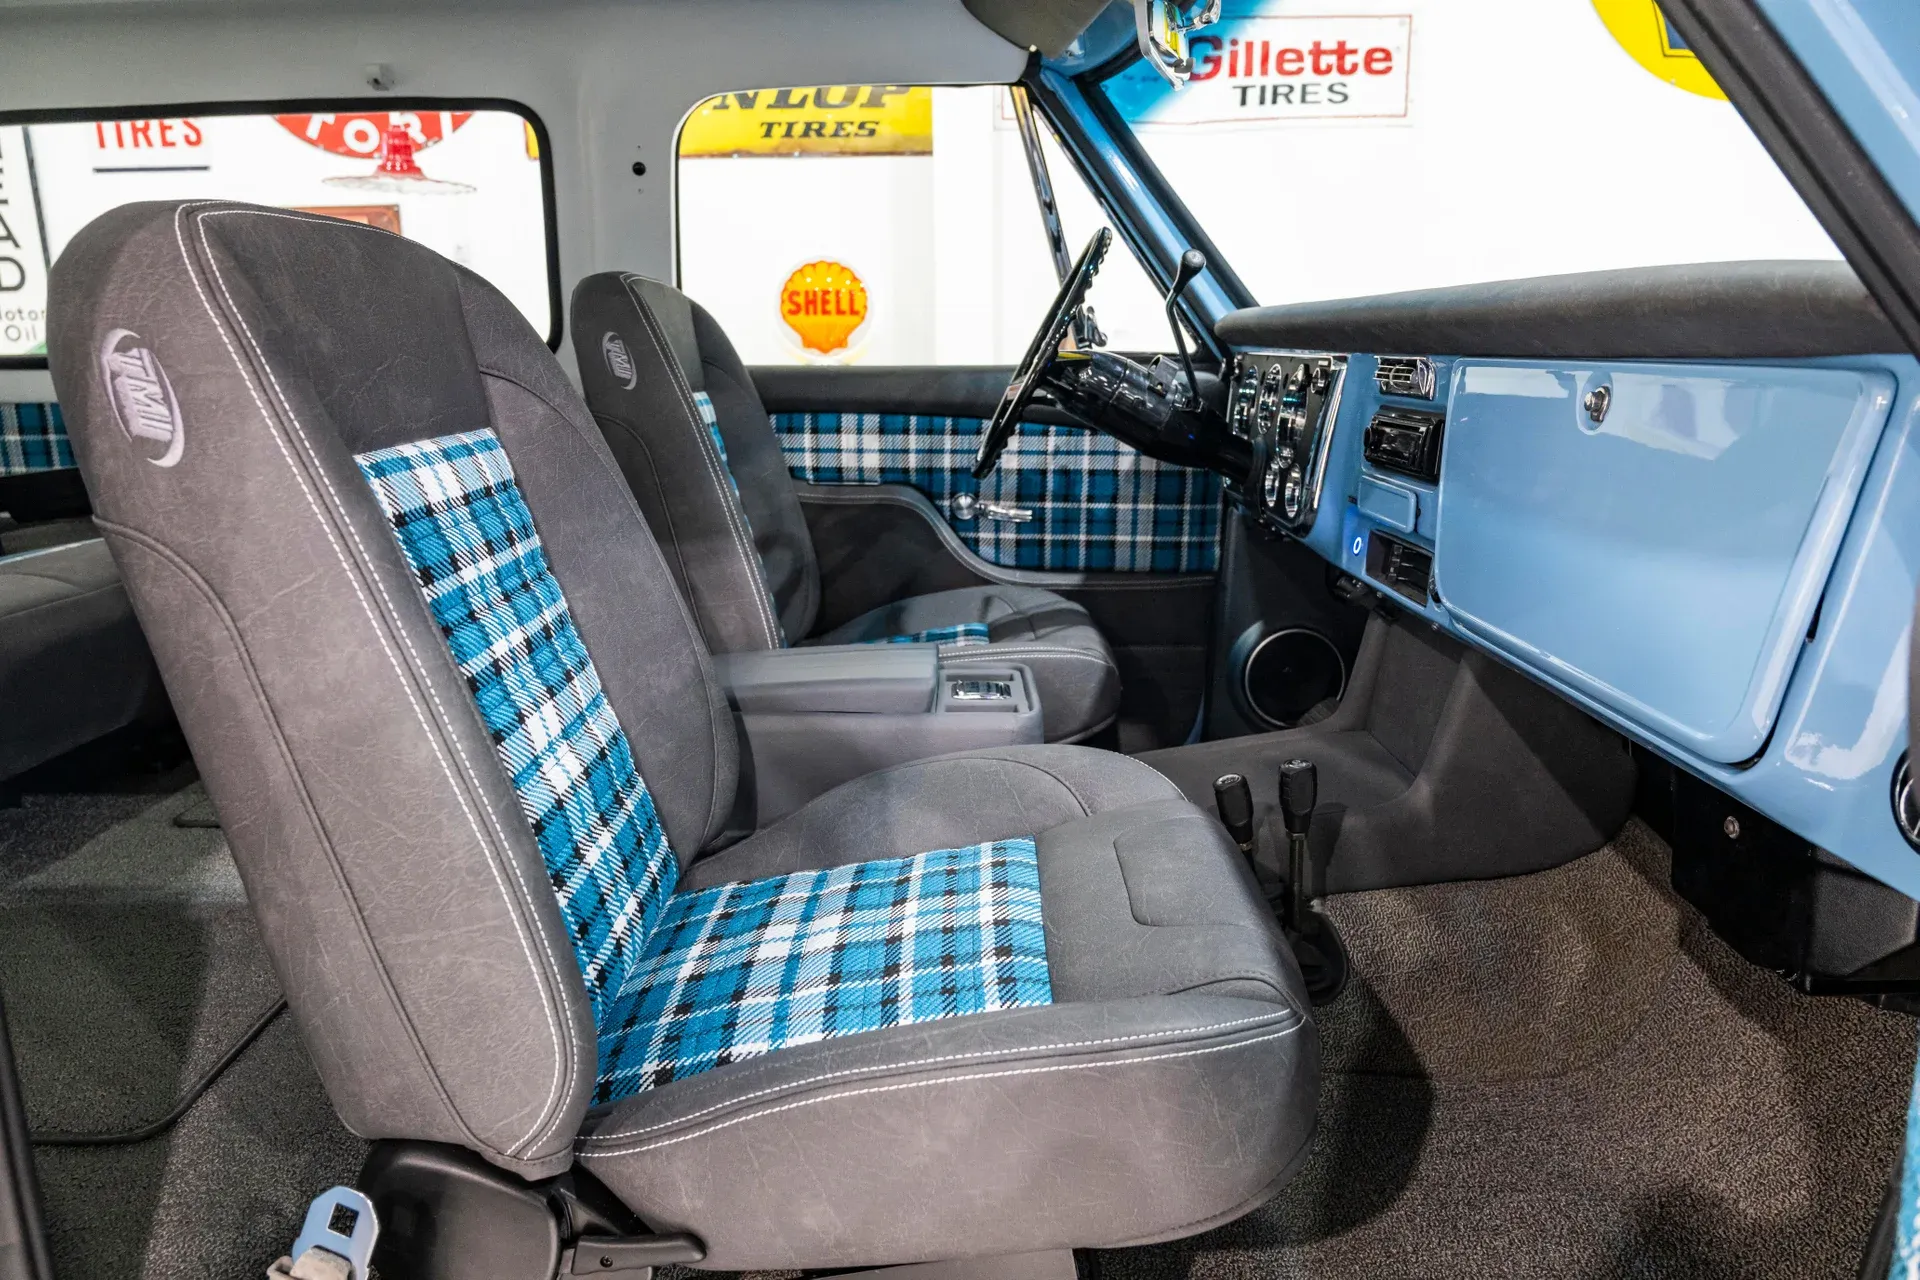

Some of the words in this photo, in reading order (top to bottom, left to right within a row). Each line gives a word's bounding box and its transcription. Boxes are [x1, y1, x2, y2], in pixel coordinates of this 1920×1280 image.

[1186, 35, 1393, 81] Gillette
[1232, 82, 1350, 107] TIRES
[760, 121, 880, 139] TIRES
[787, 289, 861, 316] SHELL
[0, 307, 45, 322] otor
[5, 325, 37, 342] Oil
